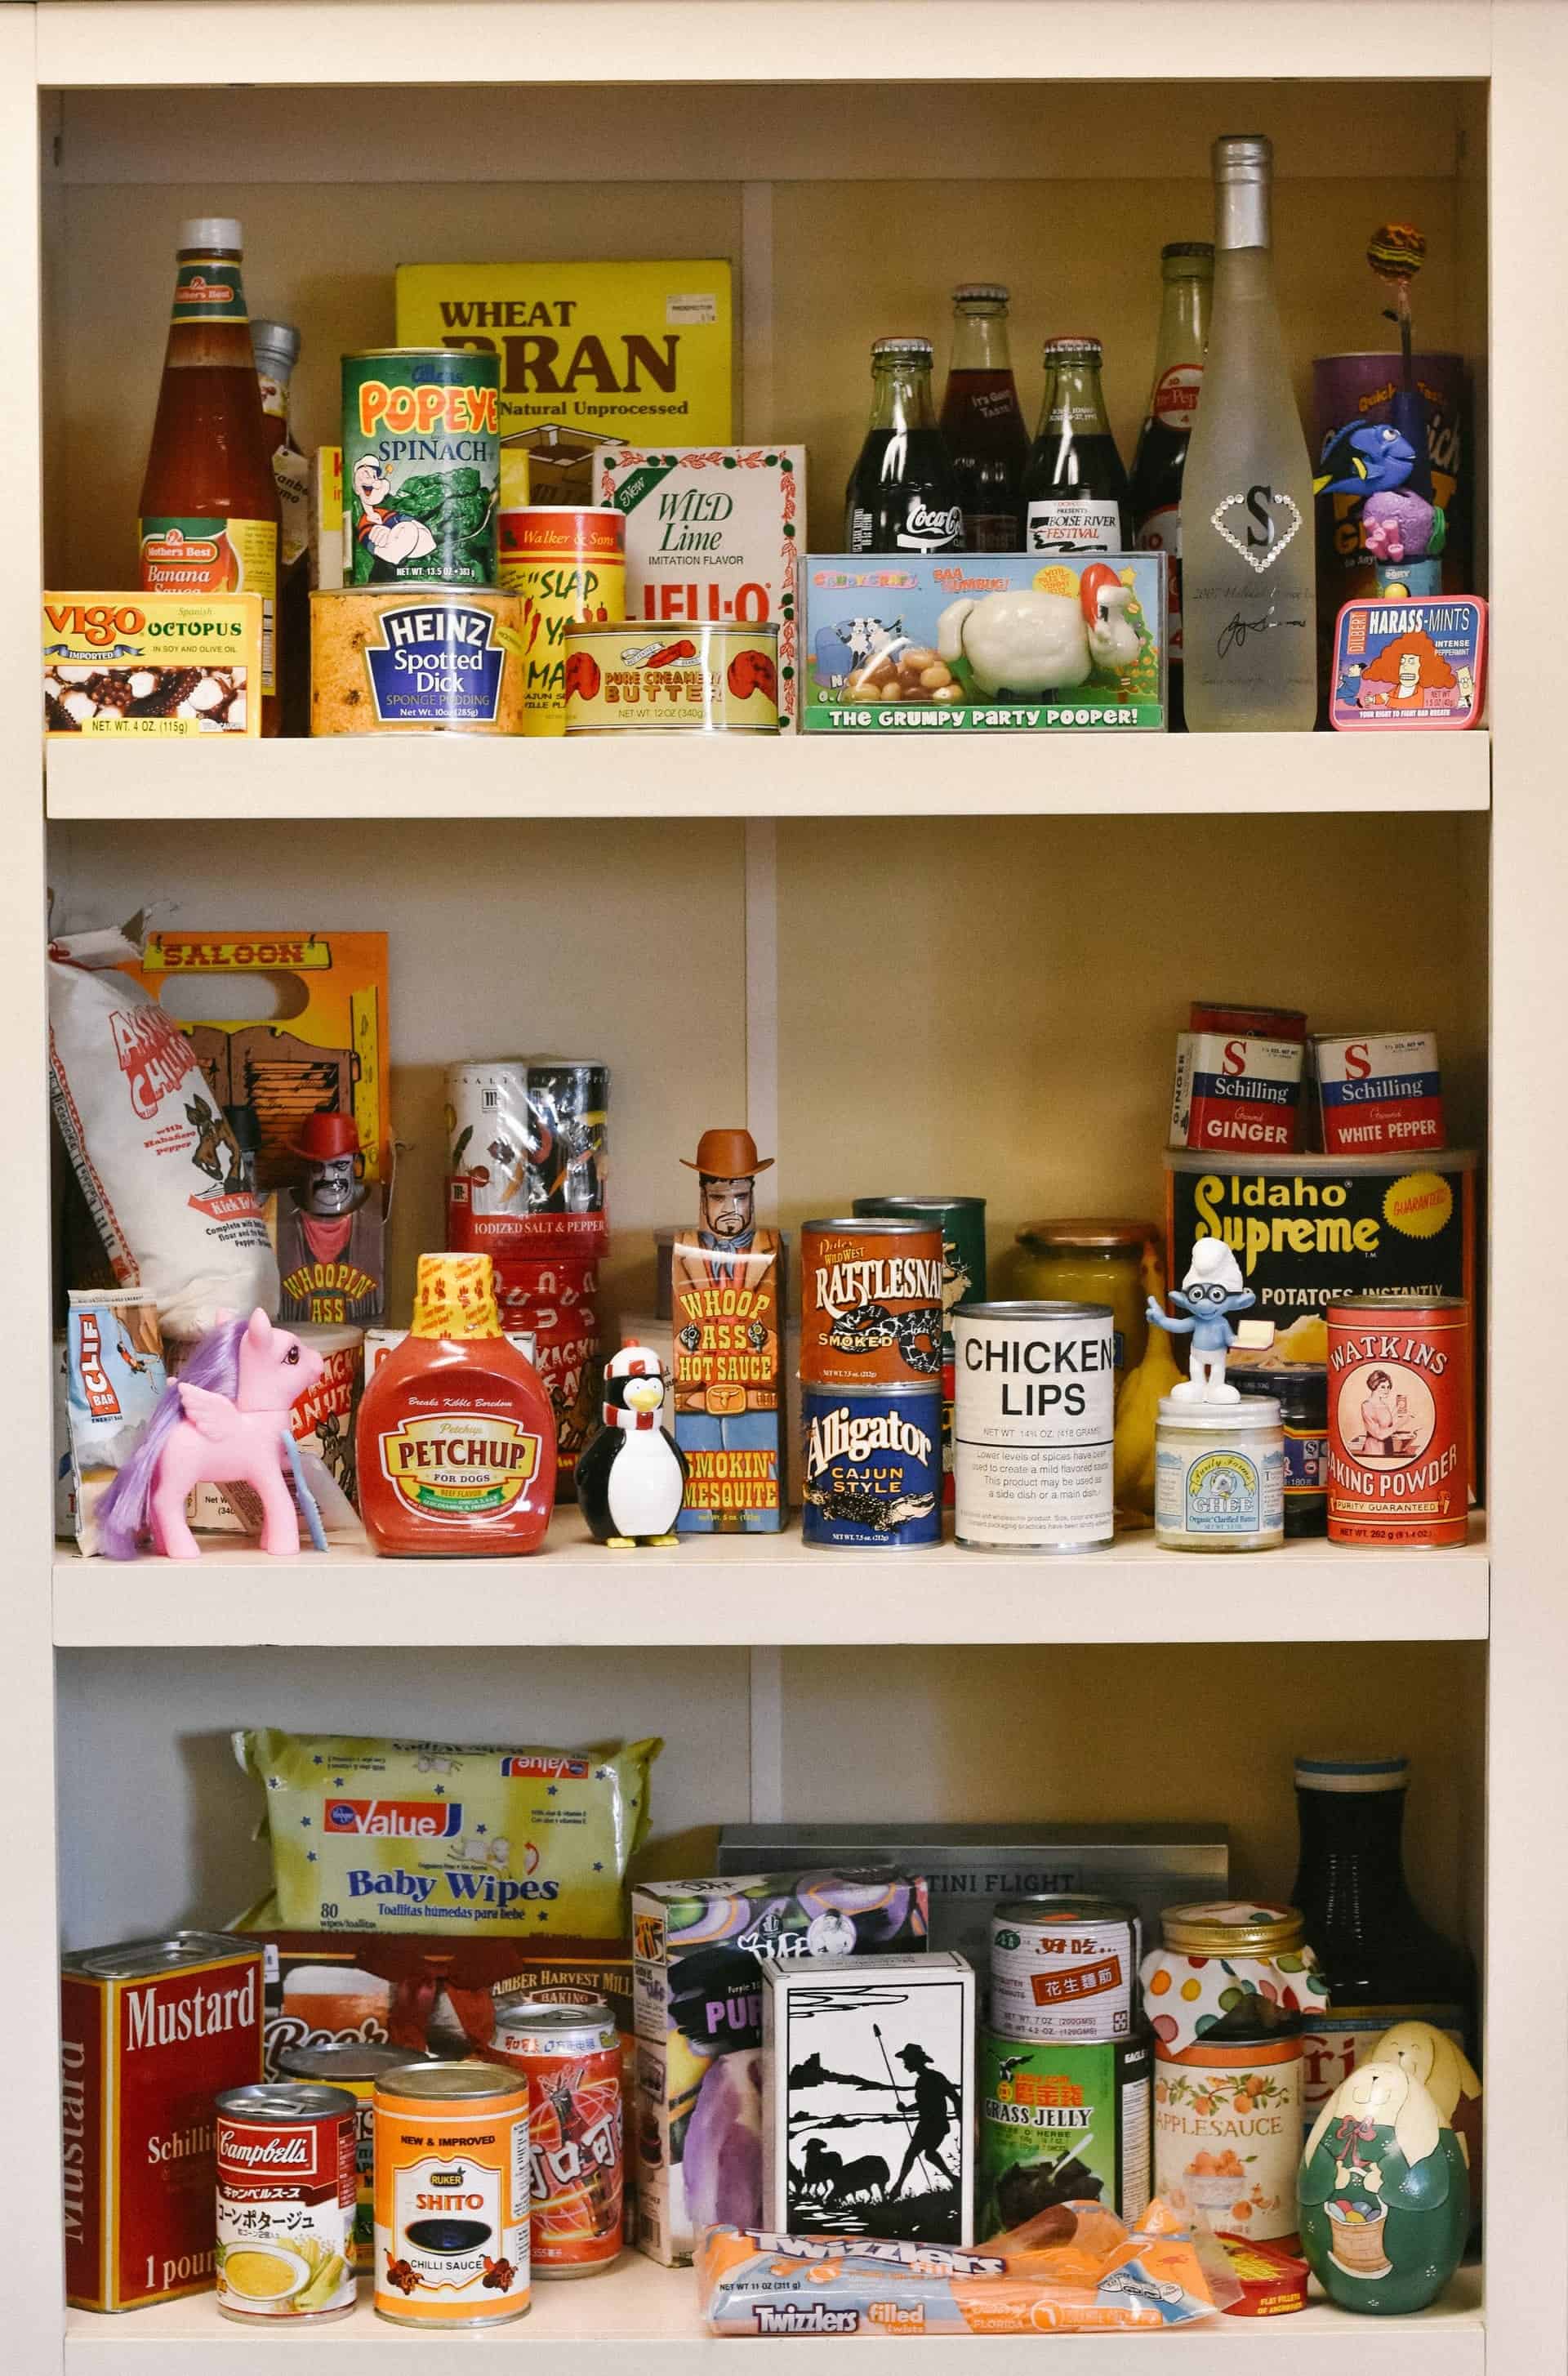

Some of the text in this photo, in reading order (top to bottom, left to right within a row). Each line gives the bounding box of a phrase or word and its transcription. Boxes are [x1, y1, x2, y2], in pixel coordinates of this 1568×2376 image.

[440, 301, 576, 327] WHEAT
[442, 335, 679, 393] RAN
[360, 381, 497, 437] POPEYE
[499, 401, 688, 417] Natural Unprocessed
[379, 440, 488, 461] SPINACH
[619, 476, 647, 507] New
[1049, 515, 1116, 527] BOISE RIVER
[1246, 486, 1275, 546] S
[523, 531, 614, 546] Walker Sons
[659, 523, 722, 551] Lime
[1047, 528, 1099, 539] FESTIVAL
[186, 546, 210, 557] Best
[648, 555, 744, 565] IMITATION FLAVOR
[148, 565, 210, 582] Banana
[148, 622, 242, 636] OCTOPUS
[390, 614, 486, 646] HEINZ
[1370, 608, 1469, 634] HARASS-MINTS
[1349, 611, 1367, 653] DILBERT
[1436, 640, 1469, 648] INTENSE
[69, 650, 114, 661] IMPORTED
[394, 650, 482, 674] Spotted
[417, 673, 464, 692] Dick
[386, 695, 434, 706] SPONGE
[605, 685, 723, 704] BUTTER
[400, 709, 416, 717] Net
[618, 710, 635, 718] NET
[879, 709, 964, 727] GRUMPY
[114, 720, 188, 733] WT. 4 OZ. (115g)
[163, 943, 305, 966] SALOON
[1222, 1041, 1247, 1077] S
[1345, 1043, 1372, 1080] S
[1174, 1055, 1184, 1124] GINGER
[1215, 1078, 1289, 1103] Schilling
[1342, 1079, 1423, 1101] Schilling
[1207, 1120, 1288, 1143] GINGER
[1338, 1119, 1437, 1143] WHITE PEPPER
[1232, 1176, 1348, 1206] Idaho
[206, 1223, 241, 1235] Complete
[474, 1220, 604, 1235] IODIZED SALT & PEPPER
[1194, 1175, 1381, 1277] Supreme
[283, 1263, 376, 1300] WHOOPIN'
[680, 1289, 771, 1320] WHOOP
[1262, 1288, 1353, 1306] POTATOES
[311, 1297, 345, 1323] ASS
[702, 1325, 747, 1349] ASS
[818, 1333, 893, 1347] SMOKED
[82, 1321, 107, 1393] CLIF
[965, 1338, 1112, 1374] CHICKEN
[1330, 1335, 1449, 1375] WATKINS
[679, 1357, 712, 1380] HOT
[717, 1357, 771, 1380] SAUCE
[92, 1395, 115, 1406] BAR
[408, 1397, 513, 1407] Breaks Kibble Boredom
[1003, 1384, 1085, 1415] LIPS
[808, 1407, 932, 1480] Alligator
[983, 1429, 998, 1437] NET
[399, 1439, 526, 1469] PETCHUP
[978, 1451, 1091, 1464] Lower levels of spices have
[685, 1452, 775, 1479] SMOKIN'
[831, 1468, 904, 1479] CAJUN
[1000, 1465, 1027, 1473] create
[1039, 1464, 1058, 1473] mild
[1062, 1463, 1093, 1473] flavored
[1380, 1443, 1457, 1497] POWDER
[434, 1474, 490, 1483] FOR DOGS
[834, 1482, 902, 1493] STYLE
[984, 1475, 1094, 1489] This product may be used
[684, 1482, 777, 1508] MESQUITE
[996, 1490, 1014, 1499] side
[1017, 1490, 1036, 1500] dish
[1060, 1491, 1080, 1500] main
[1192, 1496, 1254, 1513] GHEE
[1337, 1501, 1436, 1512] PURITY GUARANTEED
[1340, 1528, 1352, 1536] NET
[354, 1801, 437, 1836] Value
[346, 1869, 559, 1907] Baby Wipes
[987, 1874, 1076, 1893] FLIGHT
[321, 1903, 338, 1918] 80
[378, 1903, 422, 1918] Toallitas
[474, 1906, 497, 1921] para
[492, 1969, 599, 1996] AMBER HARVEST
[541, 1992, 589, 2004] BAKING
[126, 1967, 255, 2052] Mustard
[987, 2100, 1093, 2127] GRASS JELLY
[1037, 2130, 1071, 2138] HERBE
[1156, 2112, 1283, 2137] APPLESAUCE
[64, 2042, 85, 2244] Mustard
[220, 2130, 307, 2167] Campbell's
[401, 2135, 496, 2146] NEW & IMPROVED
[431, 2174, 462, 2185] RUKER
[416, 2194, 484, 2211] SHITO
[145, 2254, 156, 2288] 1
[411, 2259, 483, 2271] CHILLI SAUCE
[720, 2283, 733, 2291] NET
[737, 2283, 750, 2291] WT
[755, 2302, 924, 2332] Twizzlers filled
